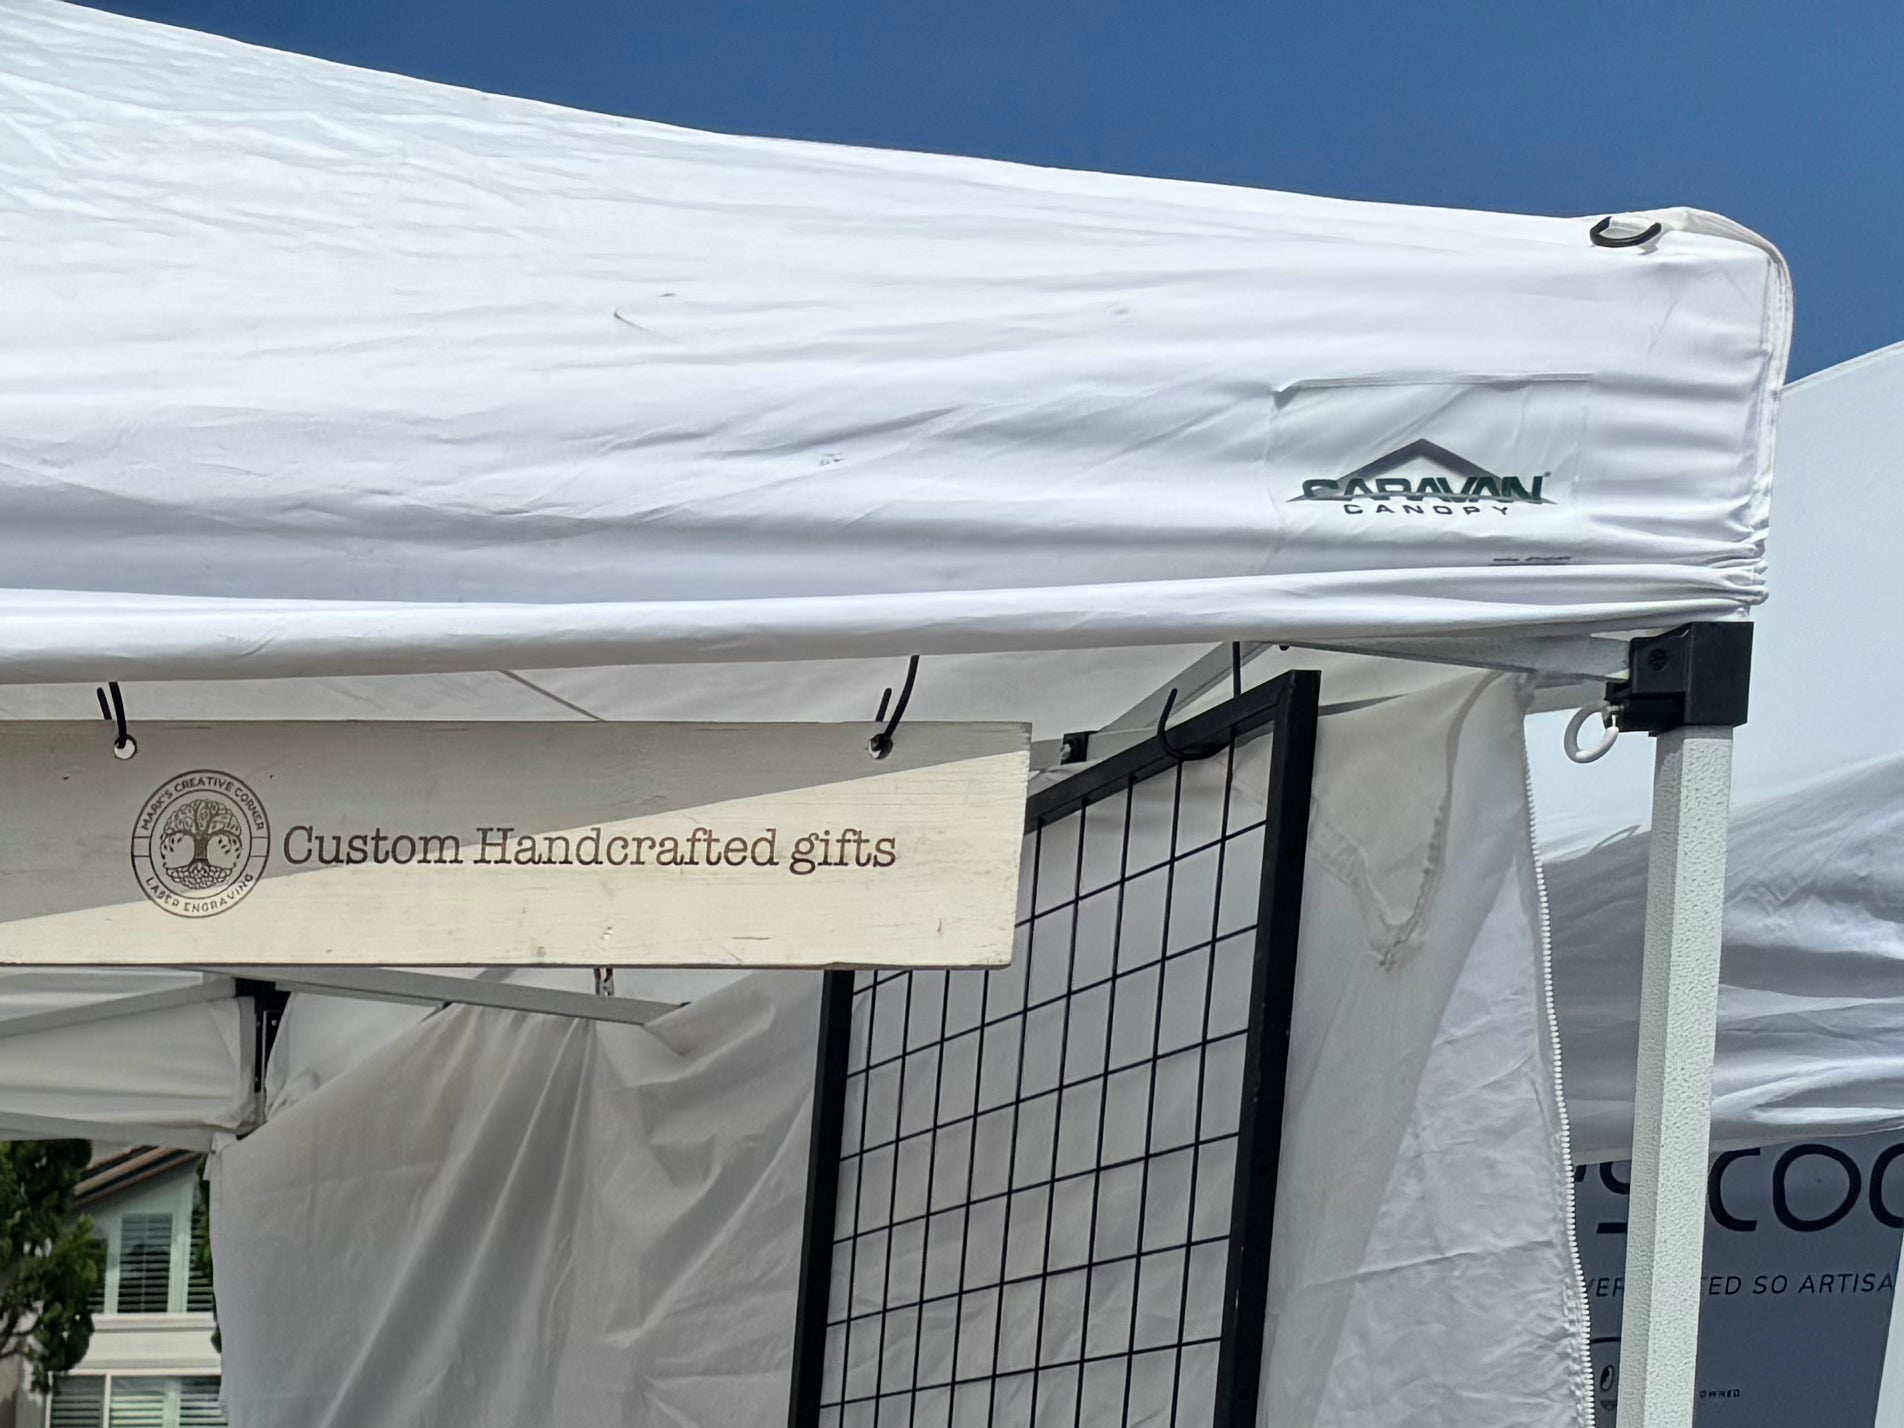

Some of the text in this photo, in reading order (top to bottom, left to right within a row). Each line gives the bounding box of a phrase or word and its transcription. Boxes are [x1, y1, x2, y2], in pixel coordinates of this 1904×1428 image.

[1302, 477, 1543, 504] CARAVAN
[1344, 505, 1508, 515] CANOPY
[174, 777, 234, 793] CREATIVE
[235, 788, 265, 830] CORNER
[282, 823, 897, 878] Custom Handcrafted gifts
[1752, 1275, 1787, 1295] SO
